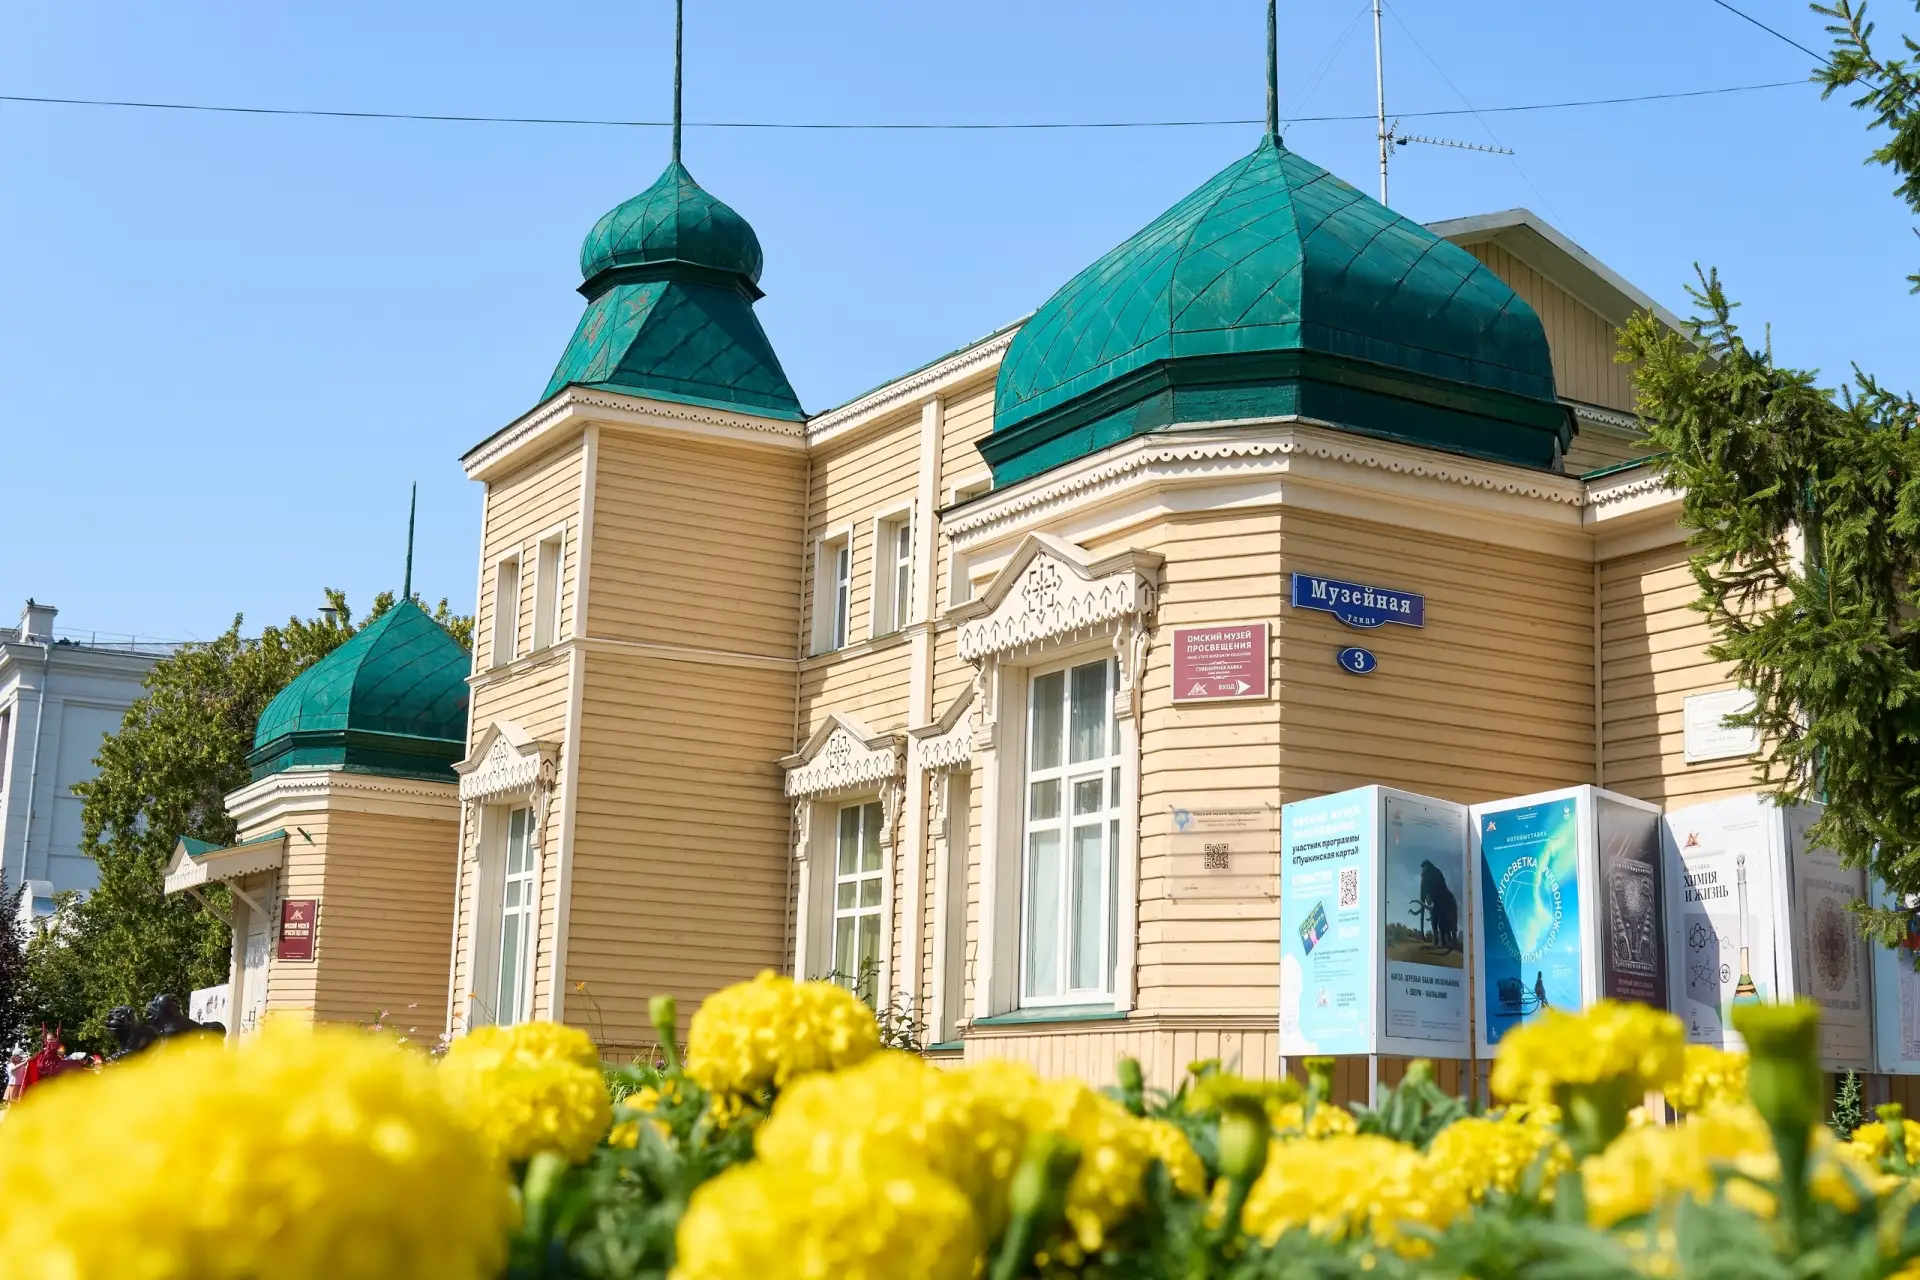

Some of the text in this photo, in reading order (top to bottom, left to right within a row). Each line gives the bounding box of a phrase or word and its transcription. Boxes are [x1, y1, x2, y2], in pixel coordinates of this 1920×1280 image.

[1311, 580, 1411, 614] Музейная
[1347, 613, 1376, 625] улица
[1187, 631, 1251, 643] ОМСКИЙ МУЗЕЙ
[1187, 642, 1252, 652] ПРОСВЕЩЕНИЯ
[1354, 651, 1365, 669] 3
[1218, 683, 1235, 691] ВХОД
[1292, 834, 1360, 855] участник программы
[1506, 830, 1547, 843] ФОТОВЫСТАВКА
[1292, 846, 1359, 866] «Пушкинская карта»
[1496, 856, 1538, 912] КРУГОСВЕТКА
[1683, 871, 1718, 888] ХИМИЯ
[1685, 884, 1729, 903] И ЖИЗНЬ
